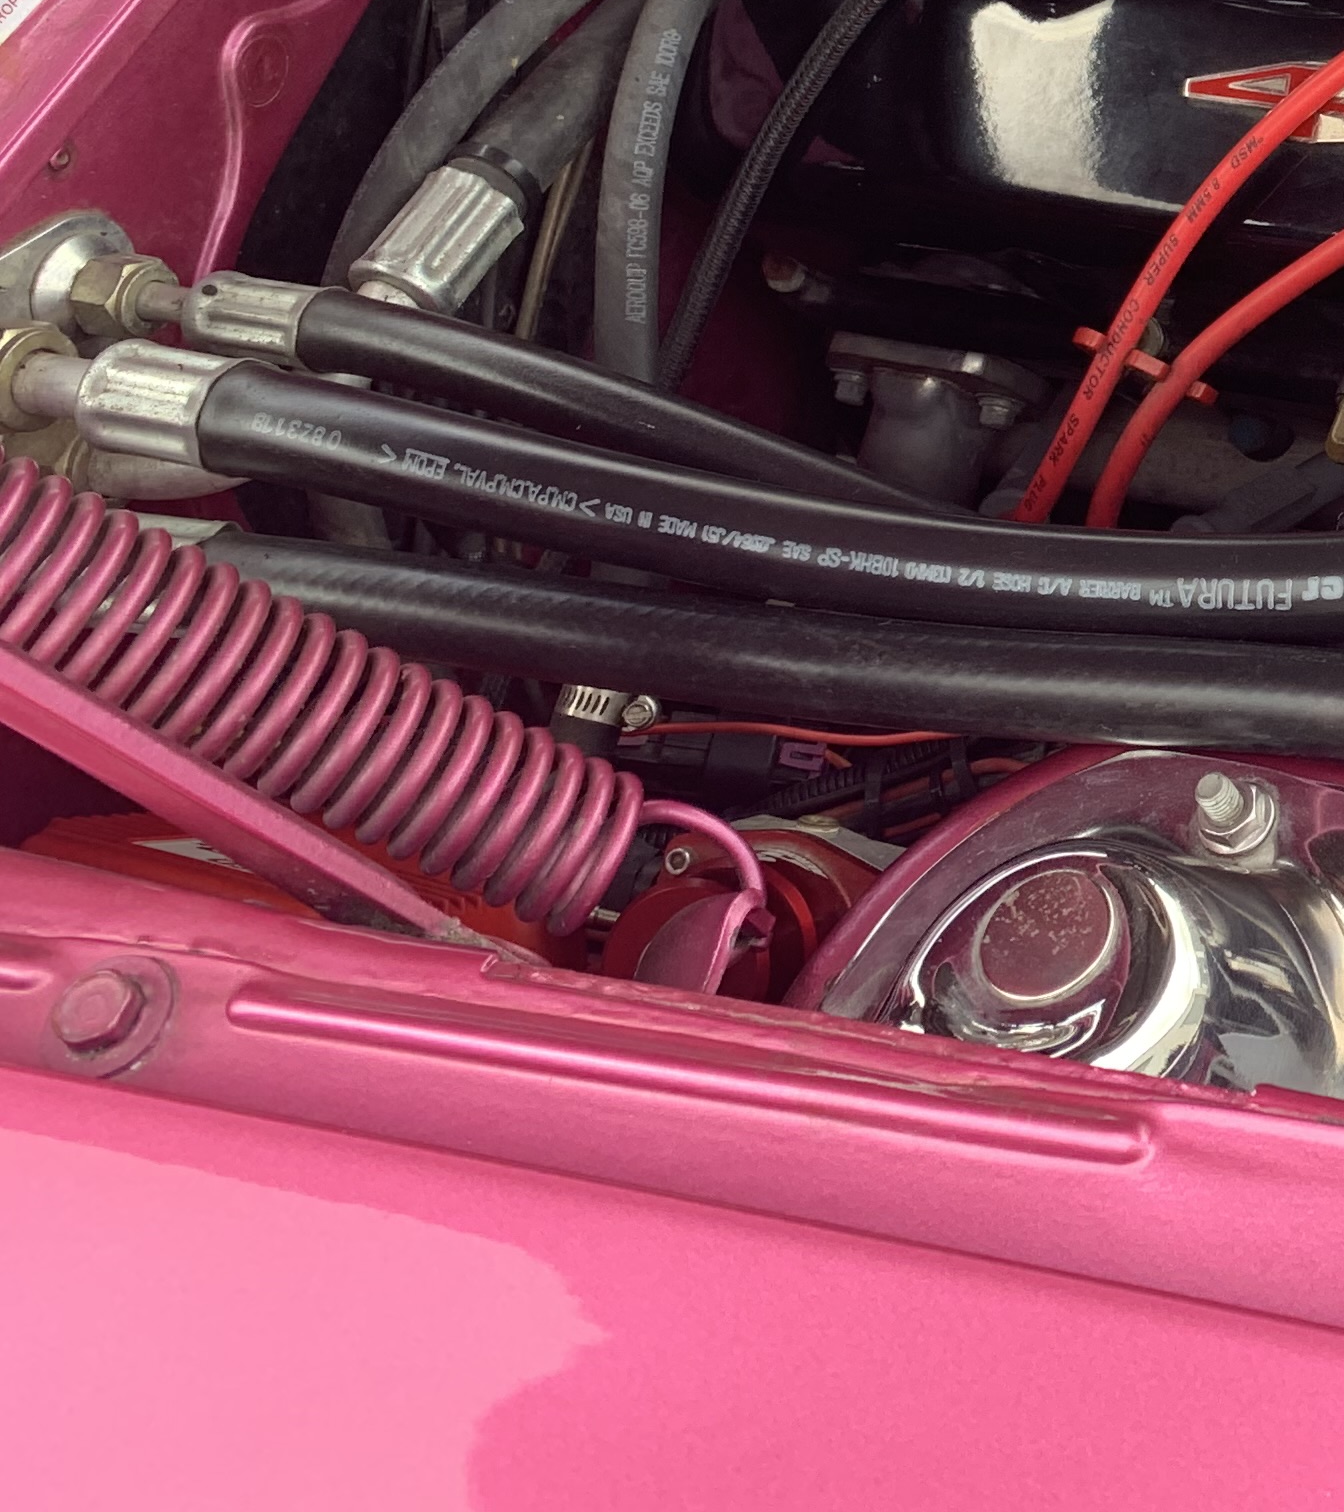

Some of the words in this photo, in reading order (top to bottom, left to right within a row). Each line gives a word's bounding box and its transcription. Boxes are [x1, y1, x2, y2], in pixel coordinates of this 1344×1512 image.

[645, 70, 671, 99] SAE
[634, 101, 664, 159] EXCEEDS
[1142, 232, 1180, 289] SUPER
[1082, 298, 1142, 402] CONDUCTOR
[1048, 412, 1081, 469] SPARK
[602, 501, 633, 524] USA
[656, 514, 697, 538] MADE
[781, 540, 811, 561] SAE
[992, 571, 1032, 593] HOSE
[1036, 575, 1072, 597] A/C
